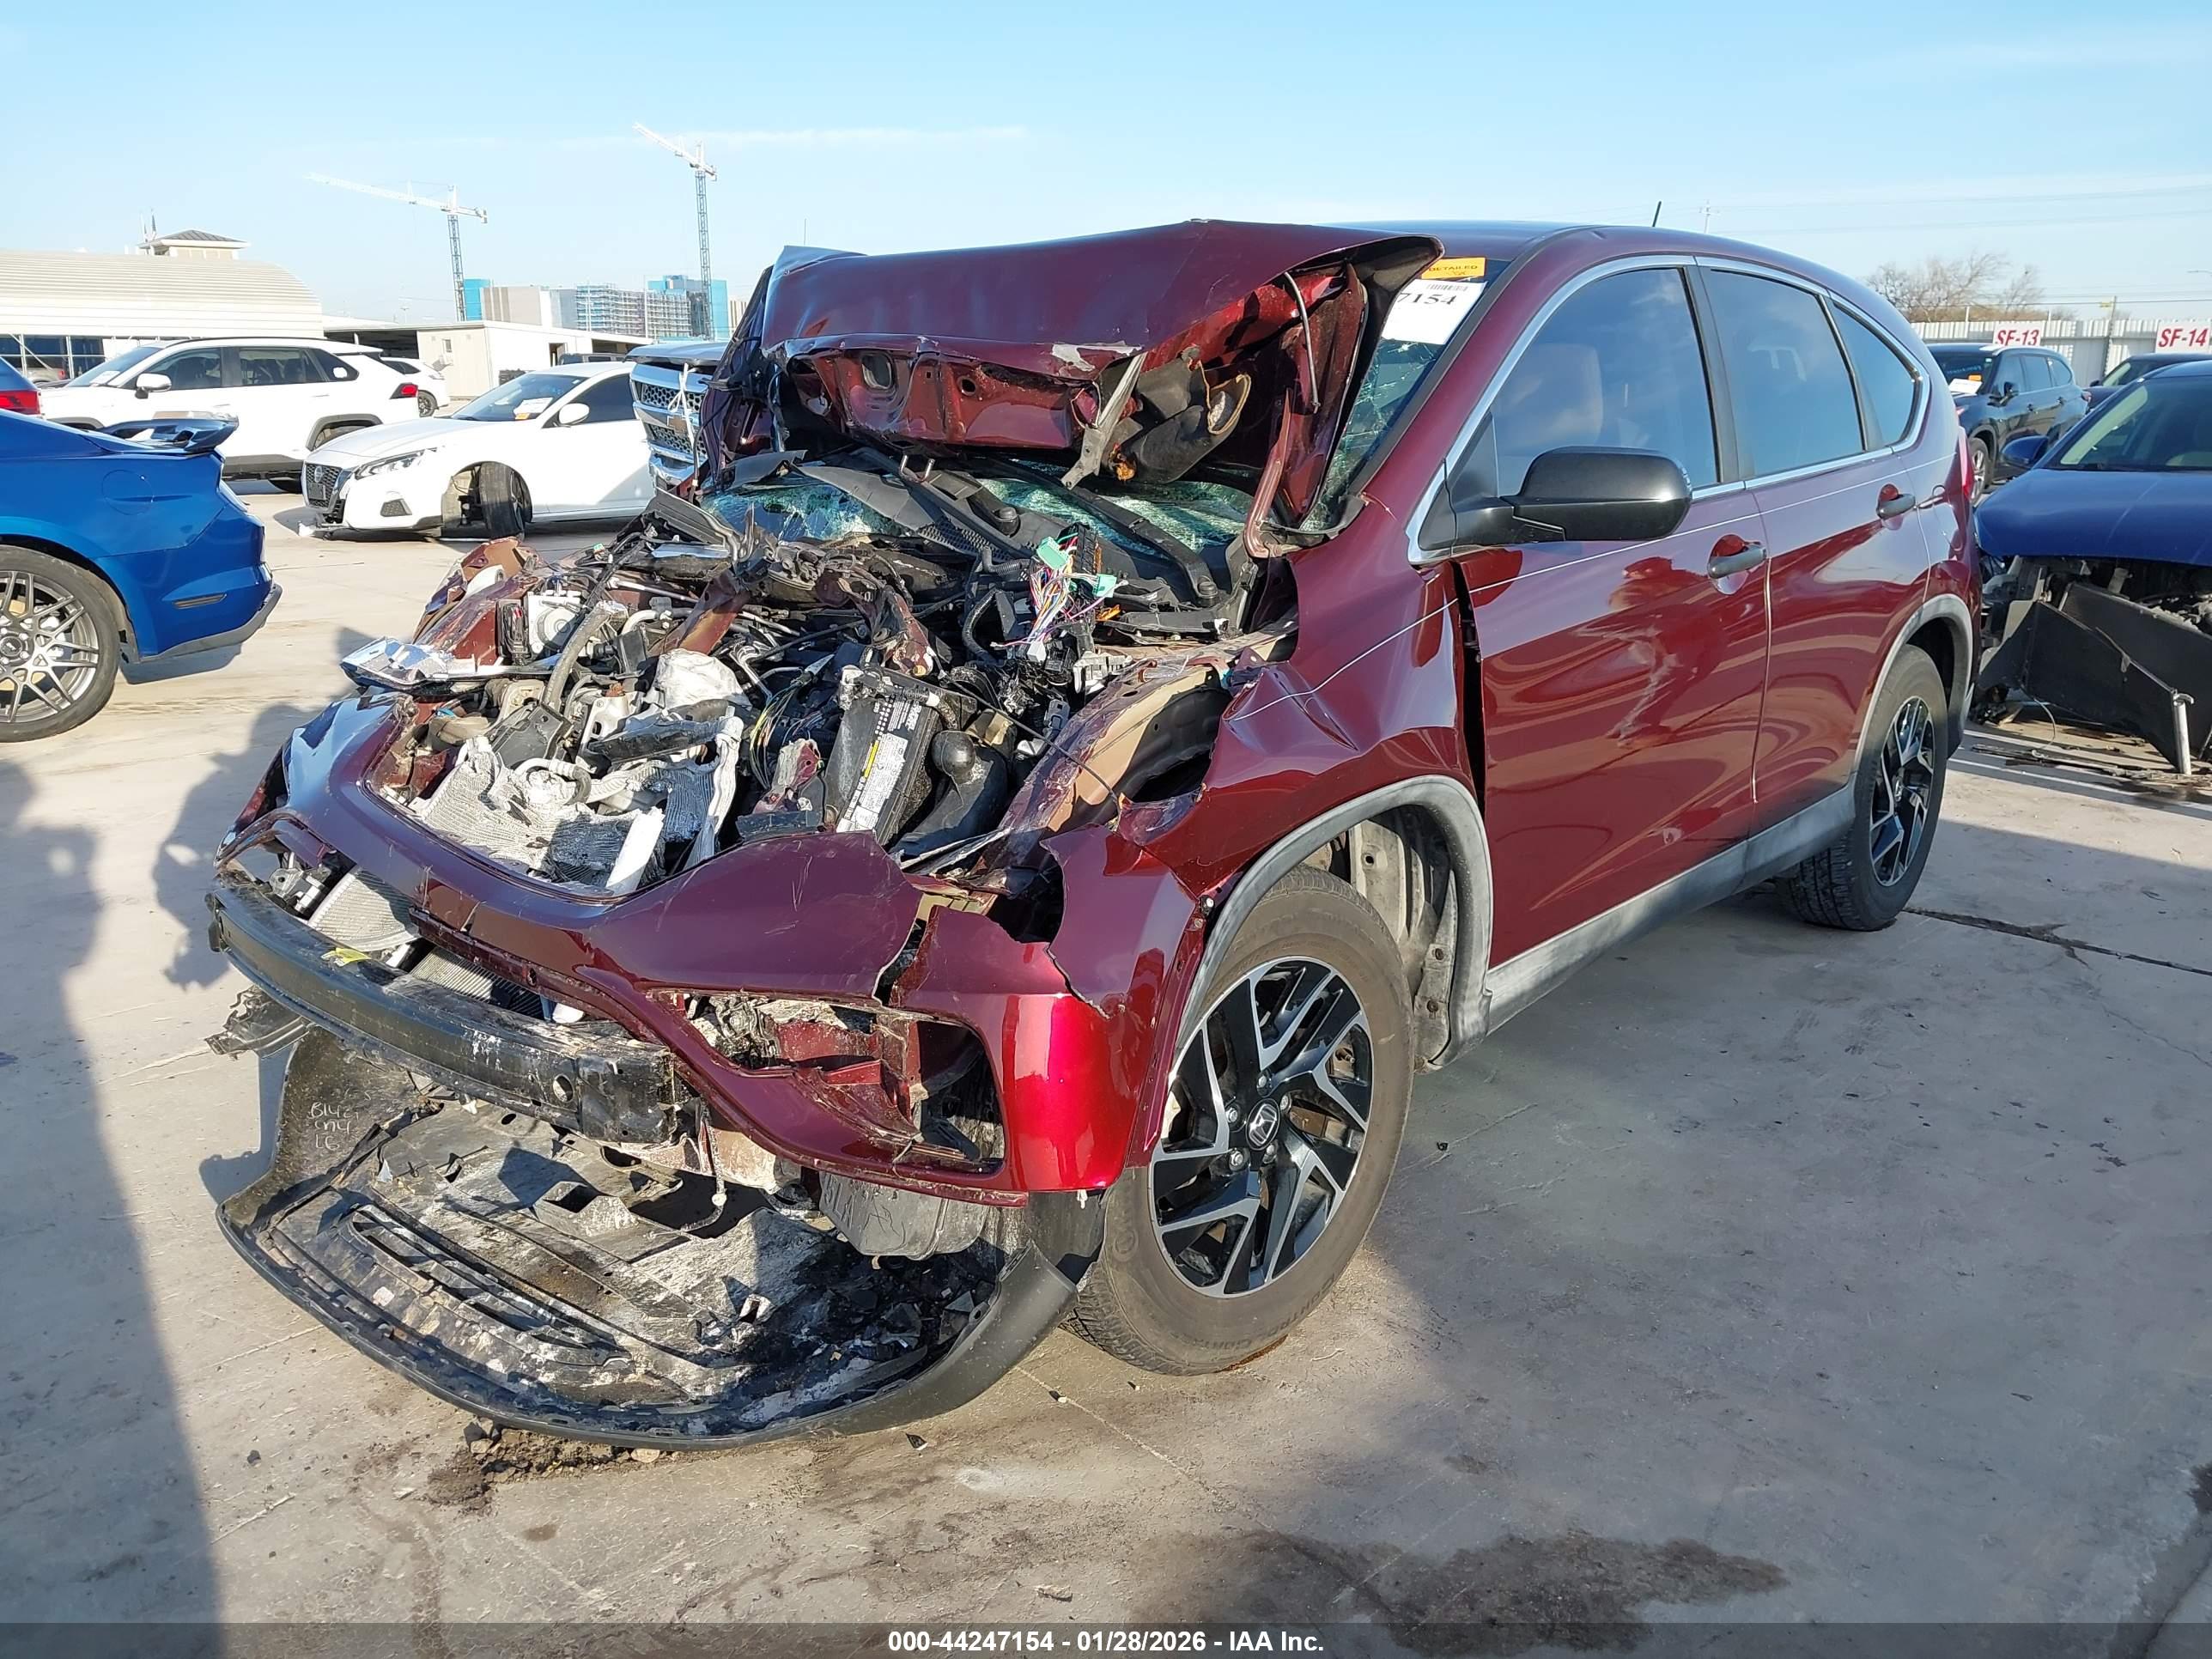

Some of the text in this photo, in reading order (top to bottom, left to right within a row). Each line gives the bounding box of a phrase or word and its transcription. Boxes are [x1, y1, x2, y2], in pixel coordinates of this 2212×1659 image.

[1397, 292, 1457, 306] 7154
[1995, 329, 2041, 346] SF-13
[2158, 327, 2209, 348] SF-14
